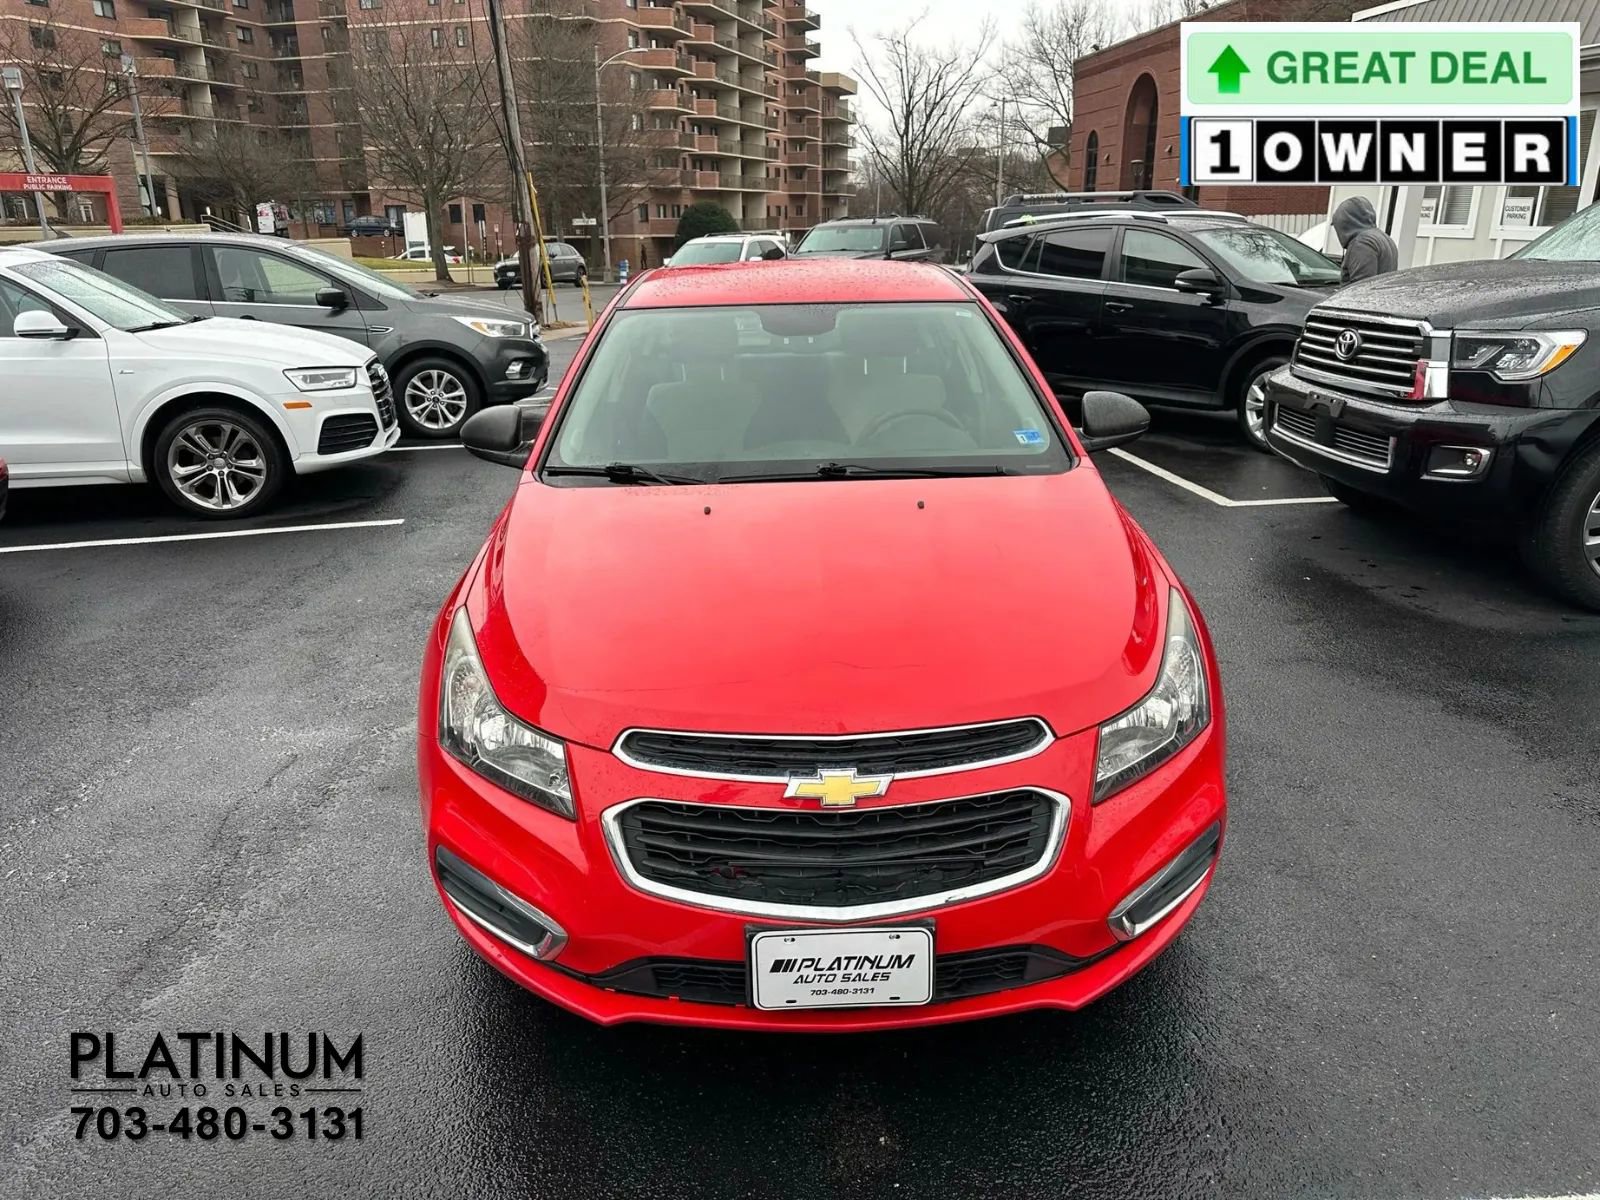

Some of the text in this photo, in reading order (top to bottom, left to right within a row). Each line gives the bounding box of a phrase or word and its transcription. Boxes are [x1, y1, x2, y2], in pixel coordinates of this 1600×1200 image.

[26, 176, 67, 184] ENTRANCE
[796, 954, 915, 972] PLATINUM
[792, 972, 892, 984] AUTO SALES
[810, 987, 875, 996] 703-480-3131
